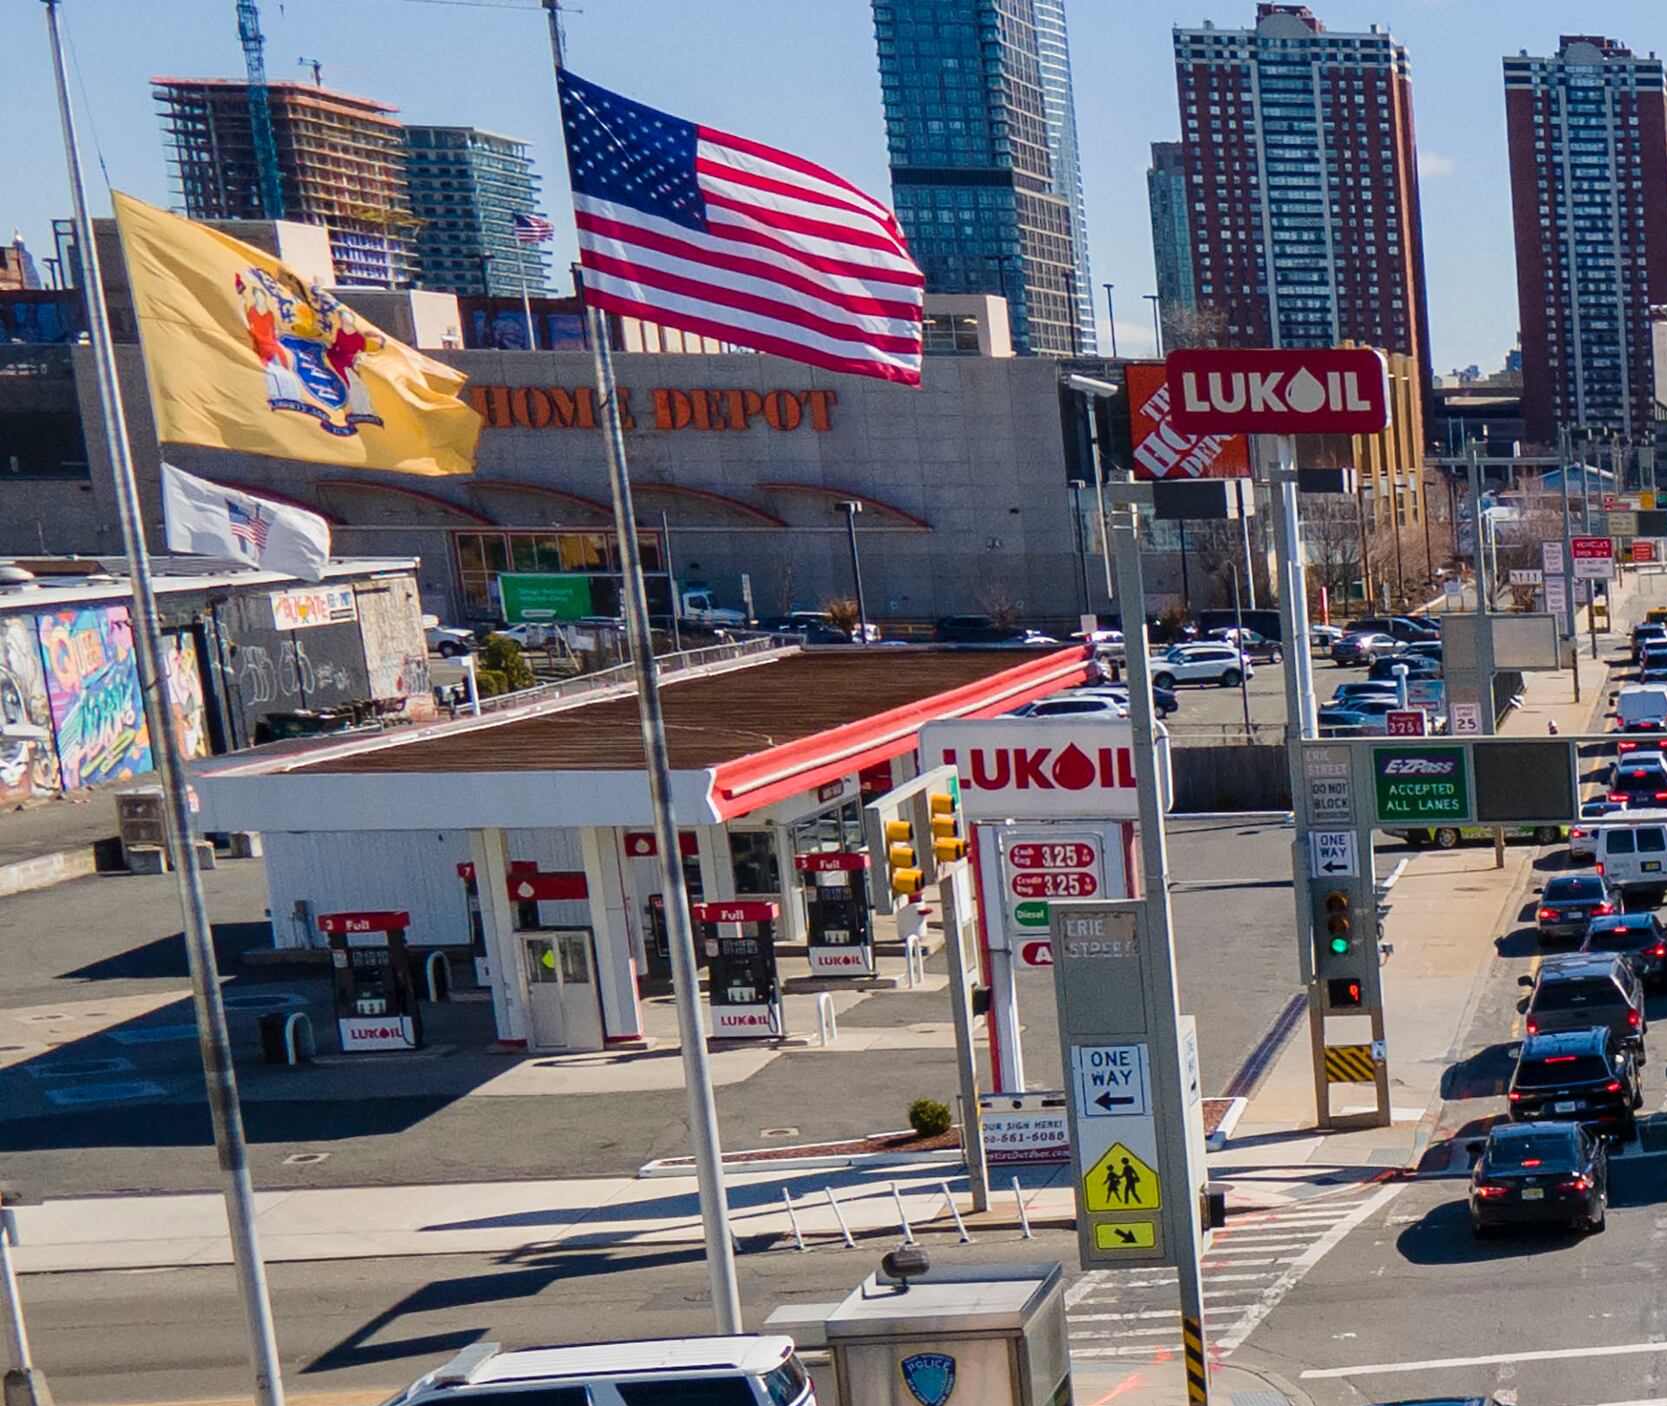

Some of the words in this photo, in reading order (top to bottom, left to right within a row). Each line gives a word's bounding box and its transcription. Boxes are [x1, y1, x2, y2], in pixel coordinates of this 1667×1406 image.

[1182, 367, 1371, 413] LUKOIL
[652, 388, 837, 432] DEPOT
[1457, 719, 1477, 730] 25
[1329, 783, 1348, 794] NOT
[1389, 783, 1455, 795] ACCEPTED
[1314, 799, 1348, 809] BLOCK
[1386, 800, 1411, 811] ALL
[1418, 799, 1460, 810] LANES
[1320, 835, 1346, 846] ONE
[1042, 846, 1077, 867] 3.25
[1320, 847, 1347, 858] WAY
[819, 860, 841, 869] Full
[1044, 874, 1080, 895] 3.25
[721, 910, 744, 920] Full
[1017, 909, 1044, 919] Diesel
[346, 920, 370, 930] Full
[1066, 920, 1104, 936] ERIE
[818, 955, 862, 966] LUKOIL
[720, 1014, 768, 1027] LUKOIL
[351, 1027, 404, 1039] LUKOIL
[1090, 1051, 1131, 1067] ONE
[1091, 1070, 1132, 1086] WAY
[982, 1122, 1004, 1132] OUR
[1007, 1121, 1030, 1132] SIGN
[907, 1359, 950, 1373] POLICE
